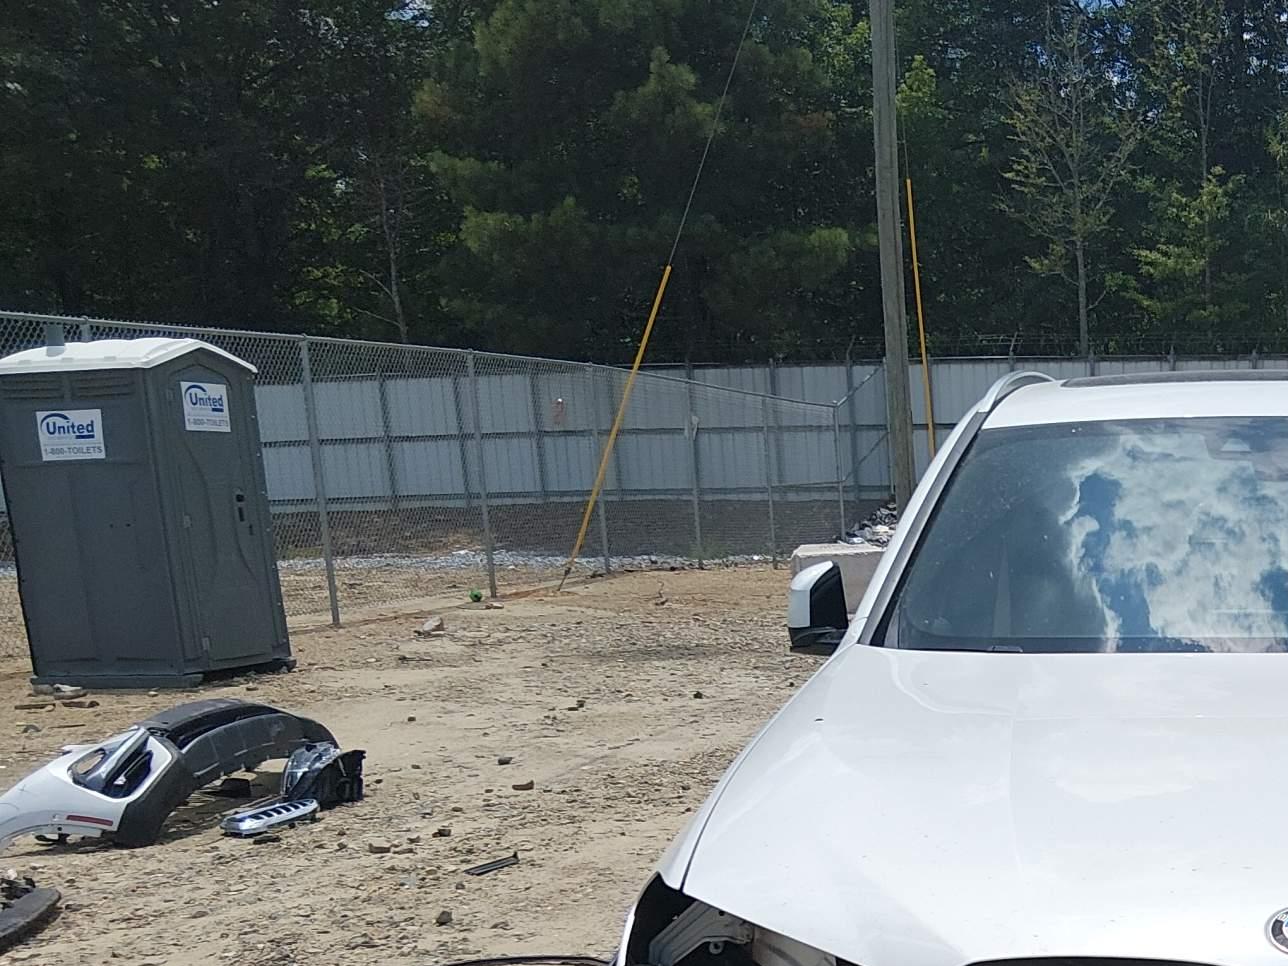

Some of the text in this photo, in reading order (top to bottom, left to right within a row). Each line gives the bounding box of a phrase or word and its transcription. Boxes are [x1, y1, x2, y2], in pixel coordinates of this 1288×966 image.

[189, 392, 224, 407] United
[46, 419, 94, 435] United
[44, 446, 103, 456] 1-800-TOILETS
